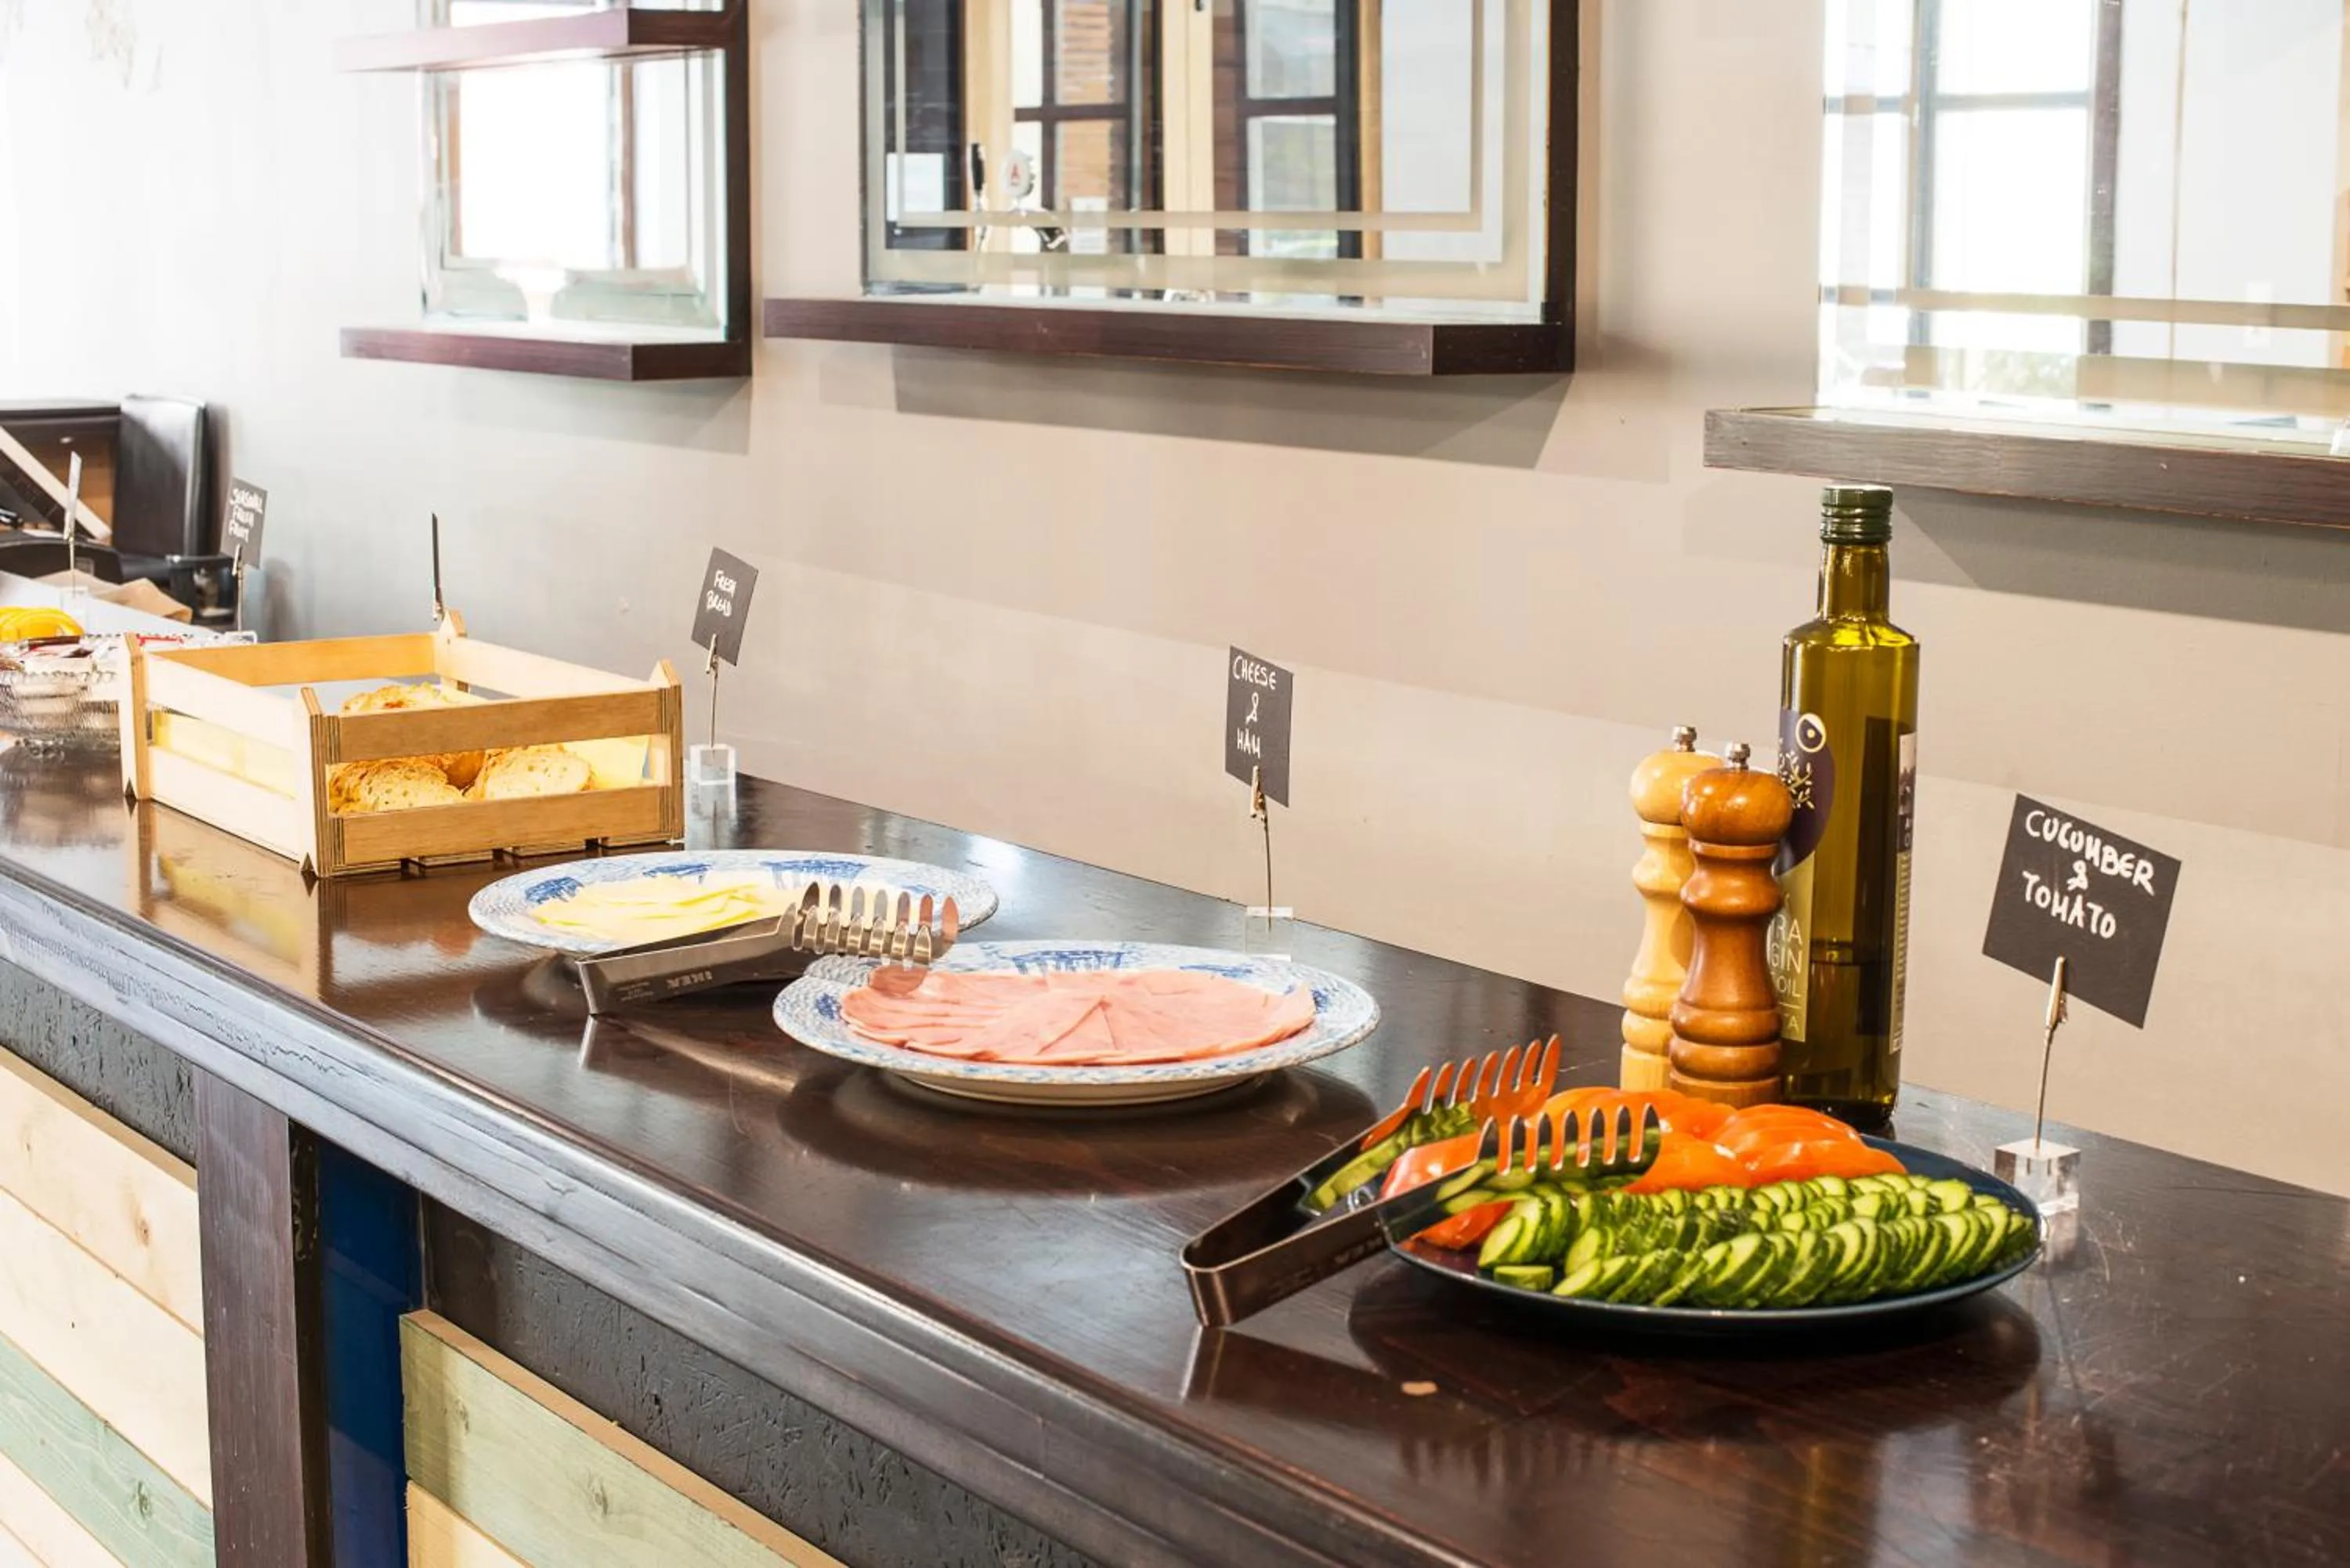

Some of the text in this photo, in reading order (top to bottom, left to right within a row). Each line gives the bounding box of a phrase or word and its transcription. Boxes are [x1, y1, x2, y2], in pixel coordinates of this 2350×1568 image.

[1232, 656, 1277, 690] CHEESE
[1246, 692, 1260, 724] &
[1236, 727, 1261, 759] HAM
[2025, 810, 2155, 896] CUCUMBER
[2022, 870, 2117, 939] TOMATO
